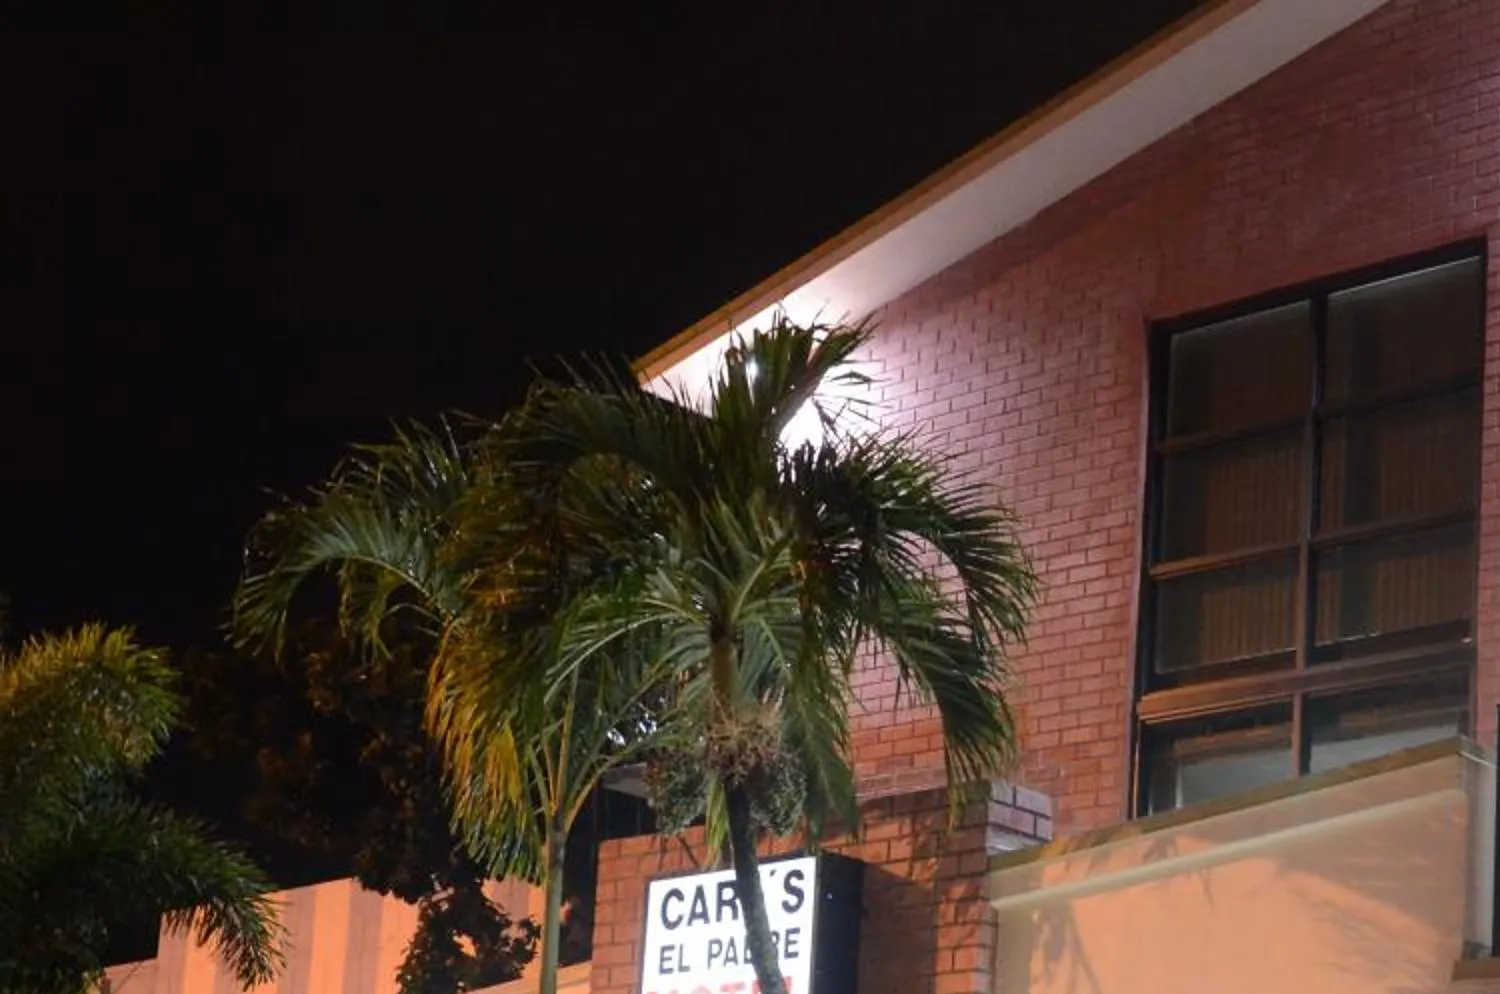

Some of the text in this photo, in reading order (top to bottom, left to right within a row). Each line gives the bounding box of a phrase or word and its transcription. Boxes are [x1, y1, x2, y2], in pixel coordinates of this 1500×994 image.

[661, 868, 806, 930] CAR'S
[659, 927, 801, 975] EL PAE
